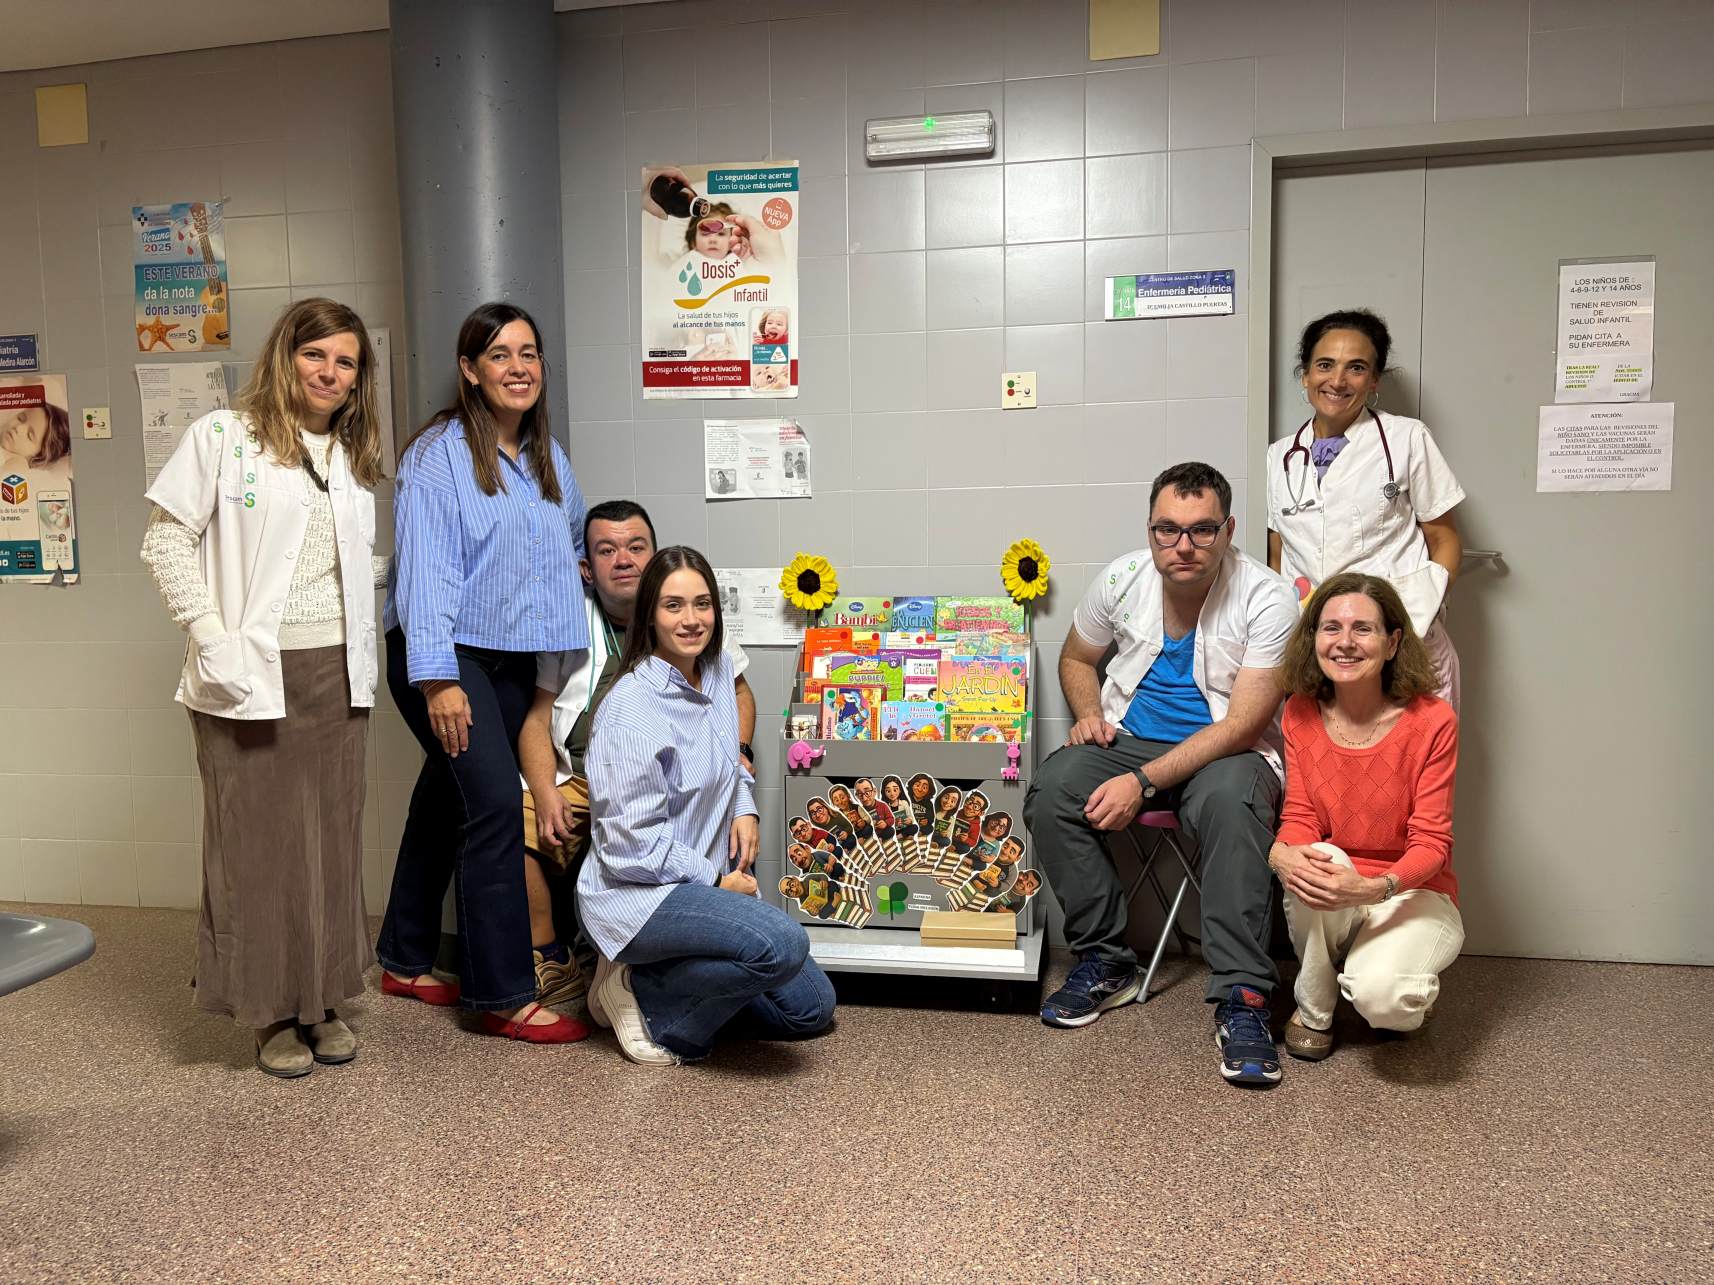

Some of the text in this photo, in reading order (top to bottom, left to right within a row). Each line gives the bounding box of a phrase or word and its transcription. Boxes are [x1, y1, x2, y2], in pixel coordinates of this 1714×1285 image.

[725, 173, 758, 182] seguridad
[753, 181, 766, 189] más
[768, 182, 792, 190] quieres
[764, 206, 789, 221] NUEVA
[144, 243, 172, 252] 2025
[144, 265, 218, 281] ESTE VERANO
[144, 287, 194, 300] da la nota
[734, 288, 768, 302] Infantil
[1138, 287, 1185, 297] Enfermería
[1188, 285, 1232, 294] Pediátrica
[145, 304, 217, 317] dona sangre...
[1120, 297, 1131, 311] 14
[1582, 340, 1630, 348] ENFERMERA
[649, 366, 672, 374] Consiga
[680, 366, 700, 374] código
[835, 613, 877, 626] Bambi
[942, 673, 1018, 697] JARDÍN
